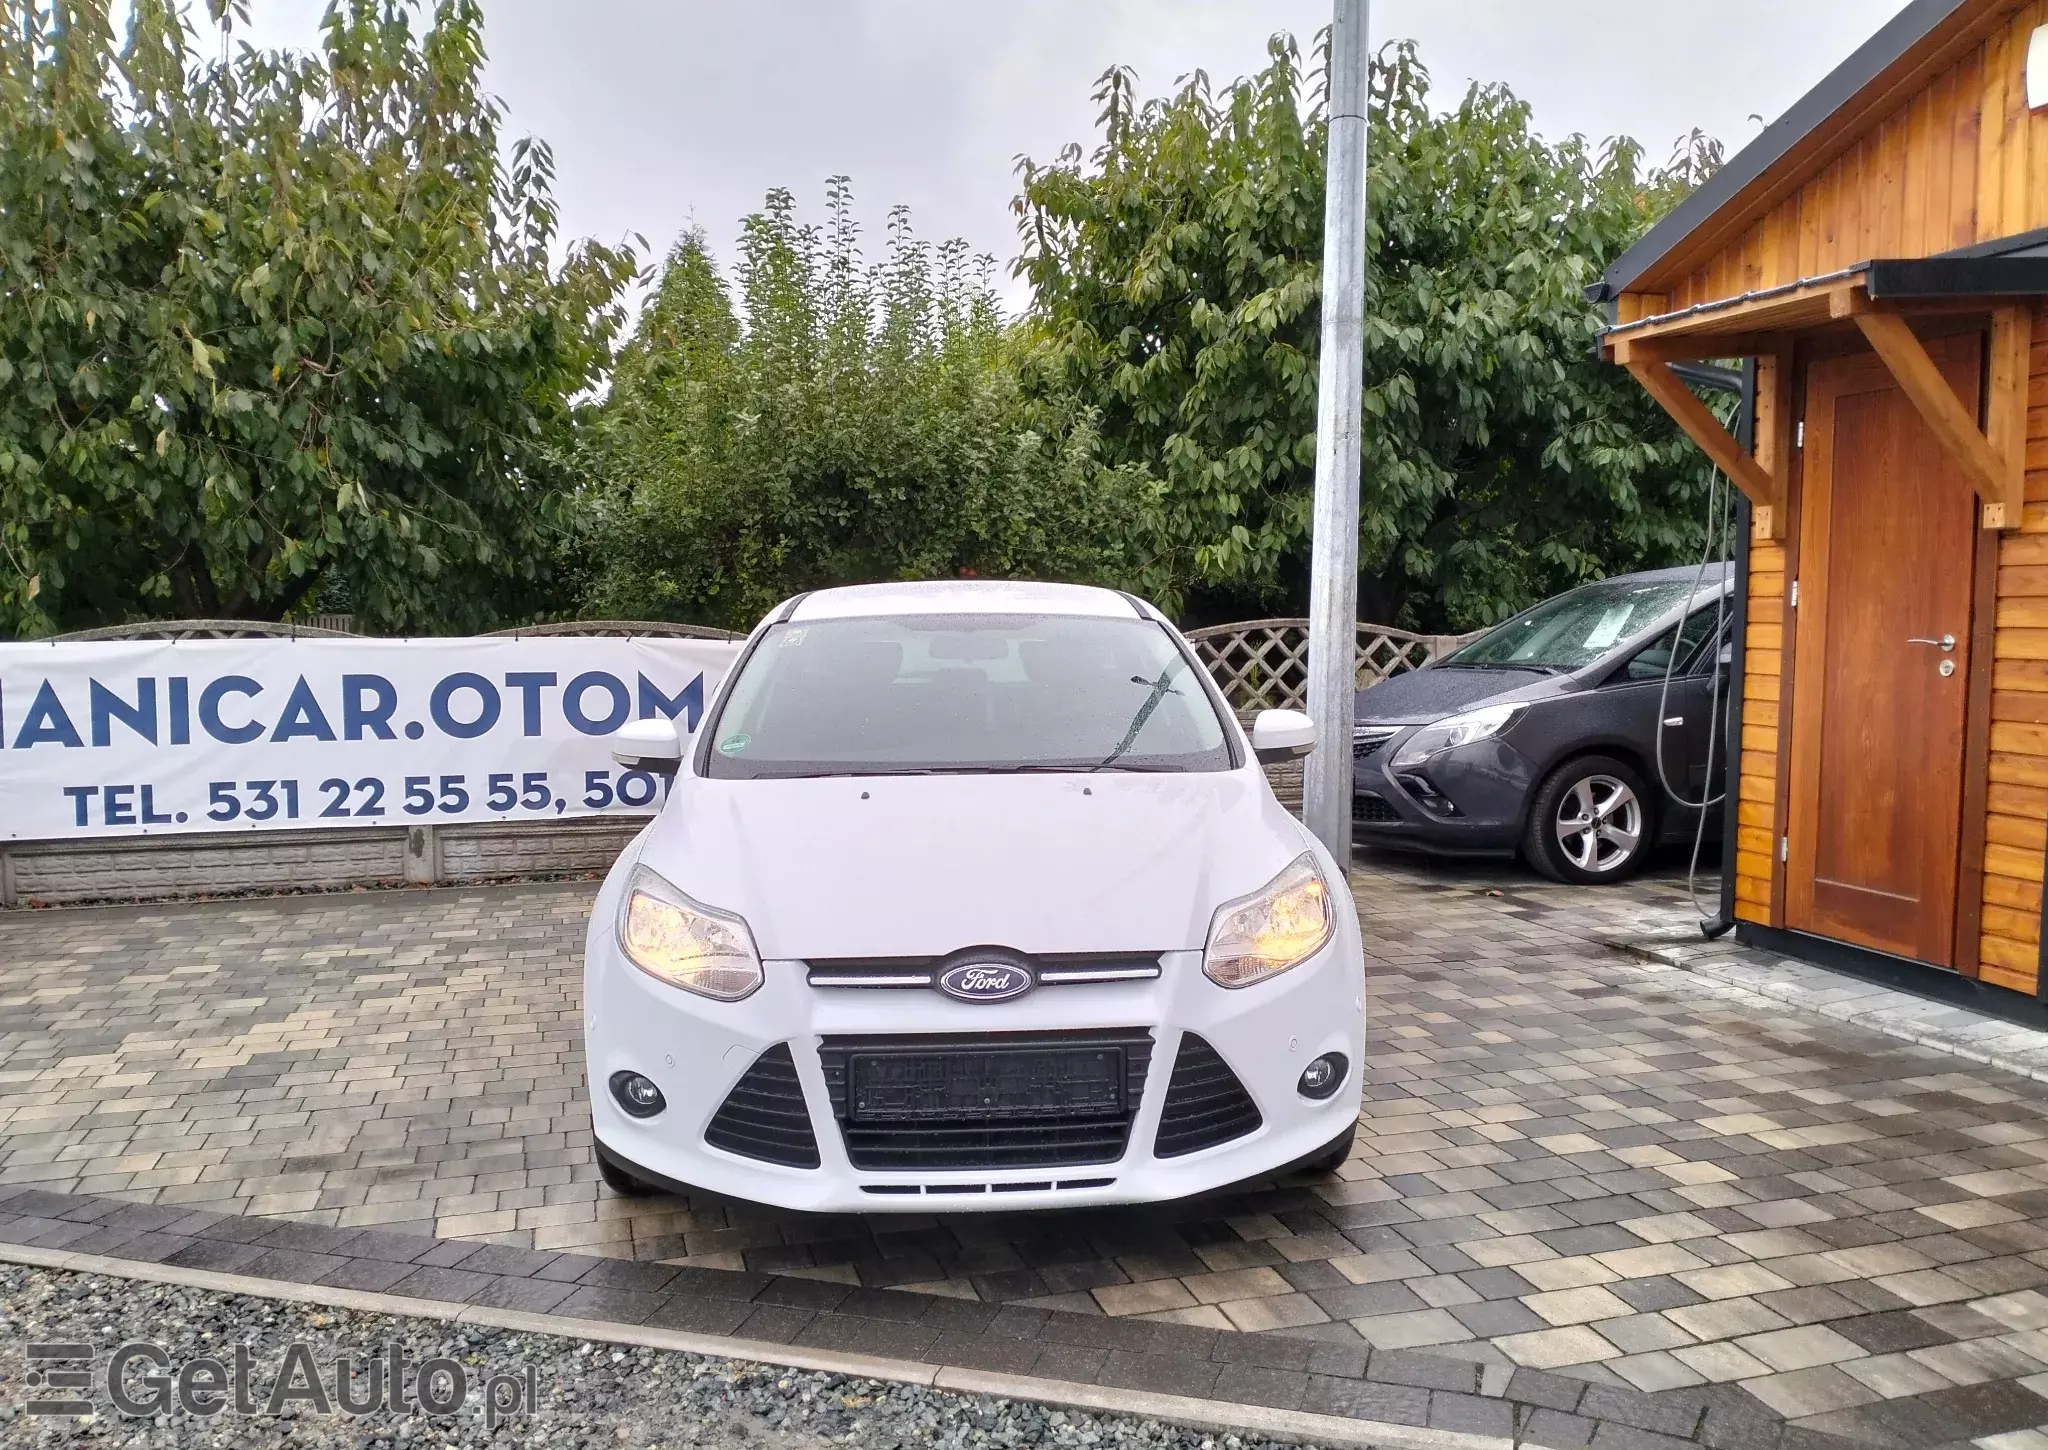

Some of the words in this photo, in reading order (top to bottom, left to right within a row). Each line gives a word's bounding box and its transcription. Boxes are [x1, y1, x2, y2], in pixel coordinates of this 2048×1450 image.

[0, 671, 705, 750] ANICAR.OTOM
[63, 785, 189, 827] TEL.
[207, 779, 299, 822] 531
[318, 777, 386, 818] 22
[402, 775, 471, 815] 55
[487, 772, 567, 816] 55,
[961, 968, 1010, 990] Ford
